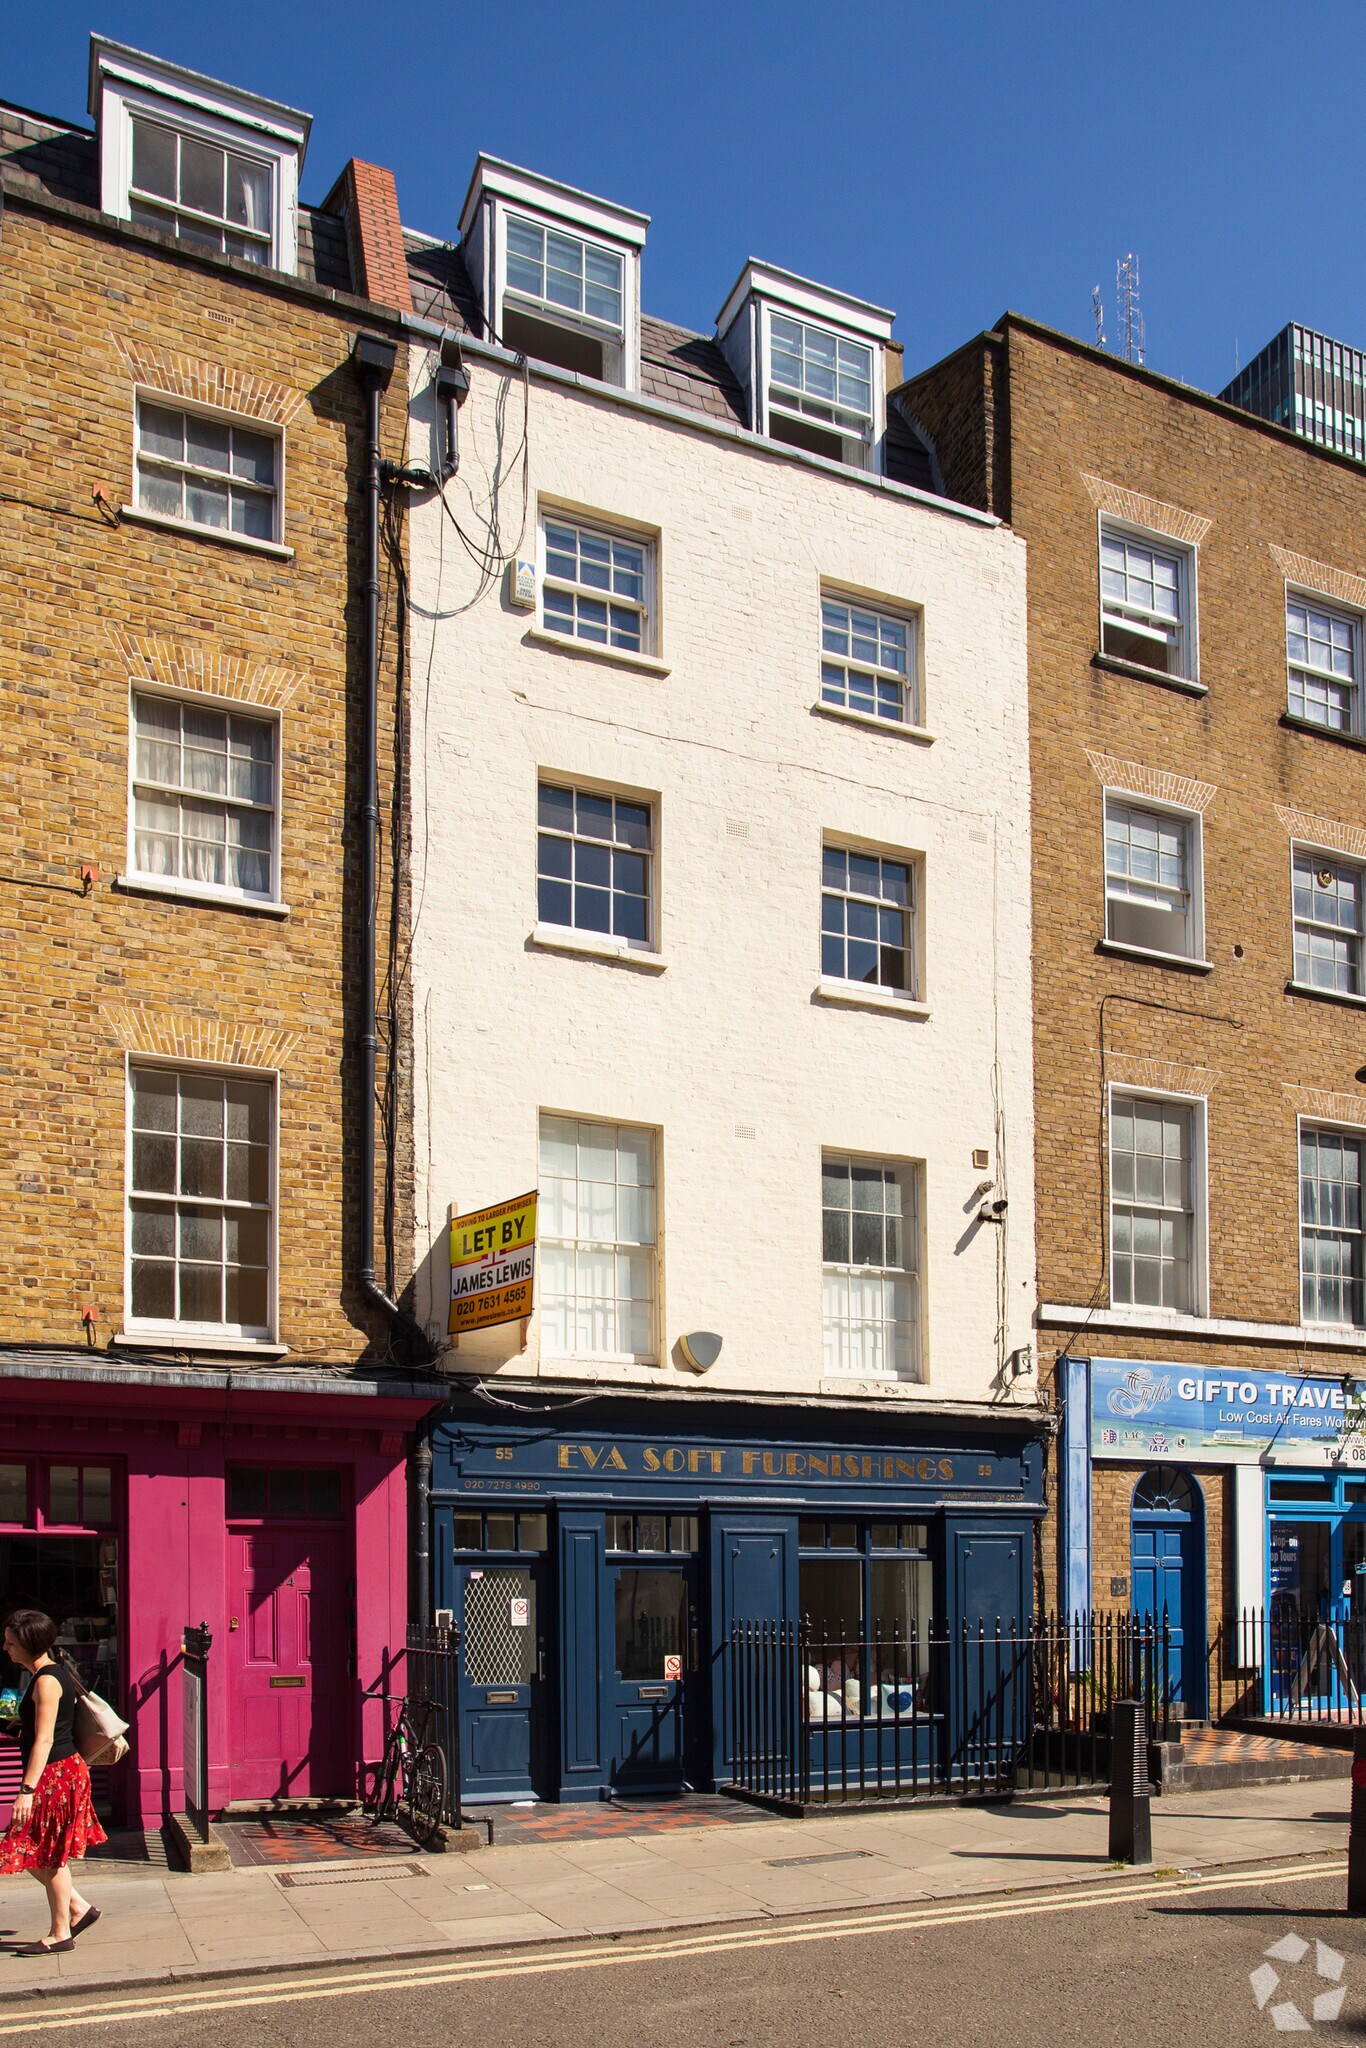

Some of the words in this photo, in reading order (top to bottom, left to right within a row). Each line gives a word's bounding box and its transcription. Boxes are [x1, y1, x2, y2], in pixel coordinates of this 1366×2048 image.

[456, 1217, 477, 1229] MOVING
[478, 1215, 485, 1223] TO
[486, 1207, 506, 1220] LARGER
[507, 1198, 532, 1213] PREMISES
[462, 1225, 496, 1256] LET
[502, 1215, 526, 1244] BY
[453, 1270, 494, 1296] JAMES
[496, 1257, 531, 1284] LEWIS
[457, 1300, 475, 1316] 020
[478, 1293, 500, 1311] 7631
[504, 1286, 526, 1304] 4565
[460, 1304, 522, 1326] www.jameslewis.co.uk
[1107, 1367, 1172, 1419] Gifto
[1178, 1378, 1258, 1405] GIFTO
[1219, 1409, 1244, 1423] Low
[1246, 1411, 1273, 1425] Cost
[1276, 1412, 1290, 1426] Air
[1293, 1414, 1322, 1427] Fares
[495, 1447, 514, 1461] 55
[557, 1444, 628, 1470] EVA
[642, 1447, 726, 1473] SOFT
[742, 1451, 954, 1481] FURNISHINGS
[977, 1464, 992, 1476] 55
[464, 1481, 485, 1490] 020
[1155, 1557, 1165, 1567] 56
[1279, 1550, 1297, 1562] Tours
